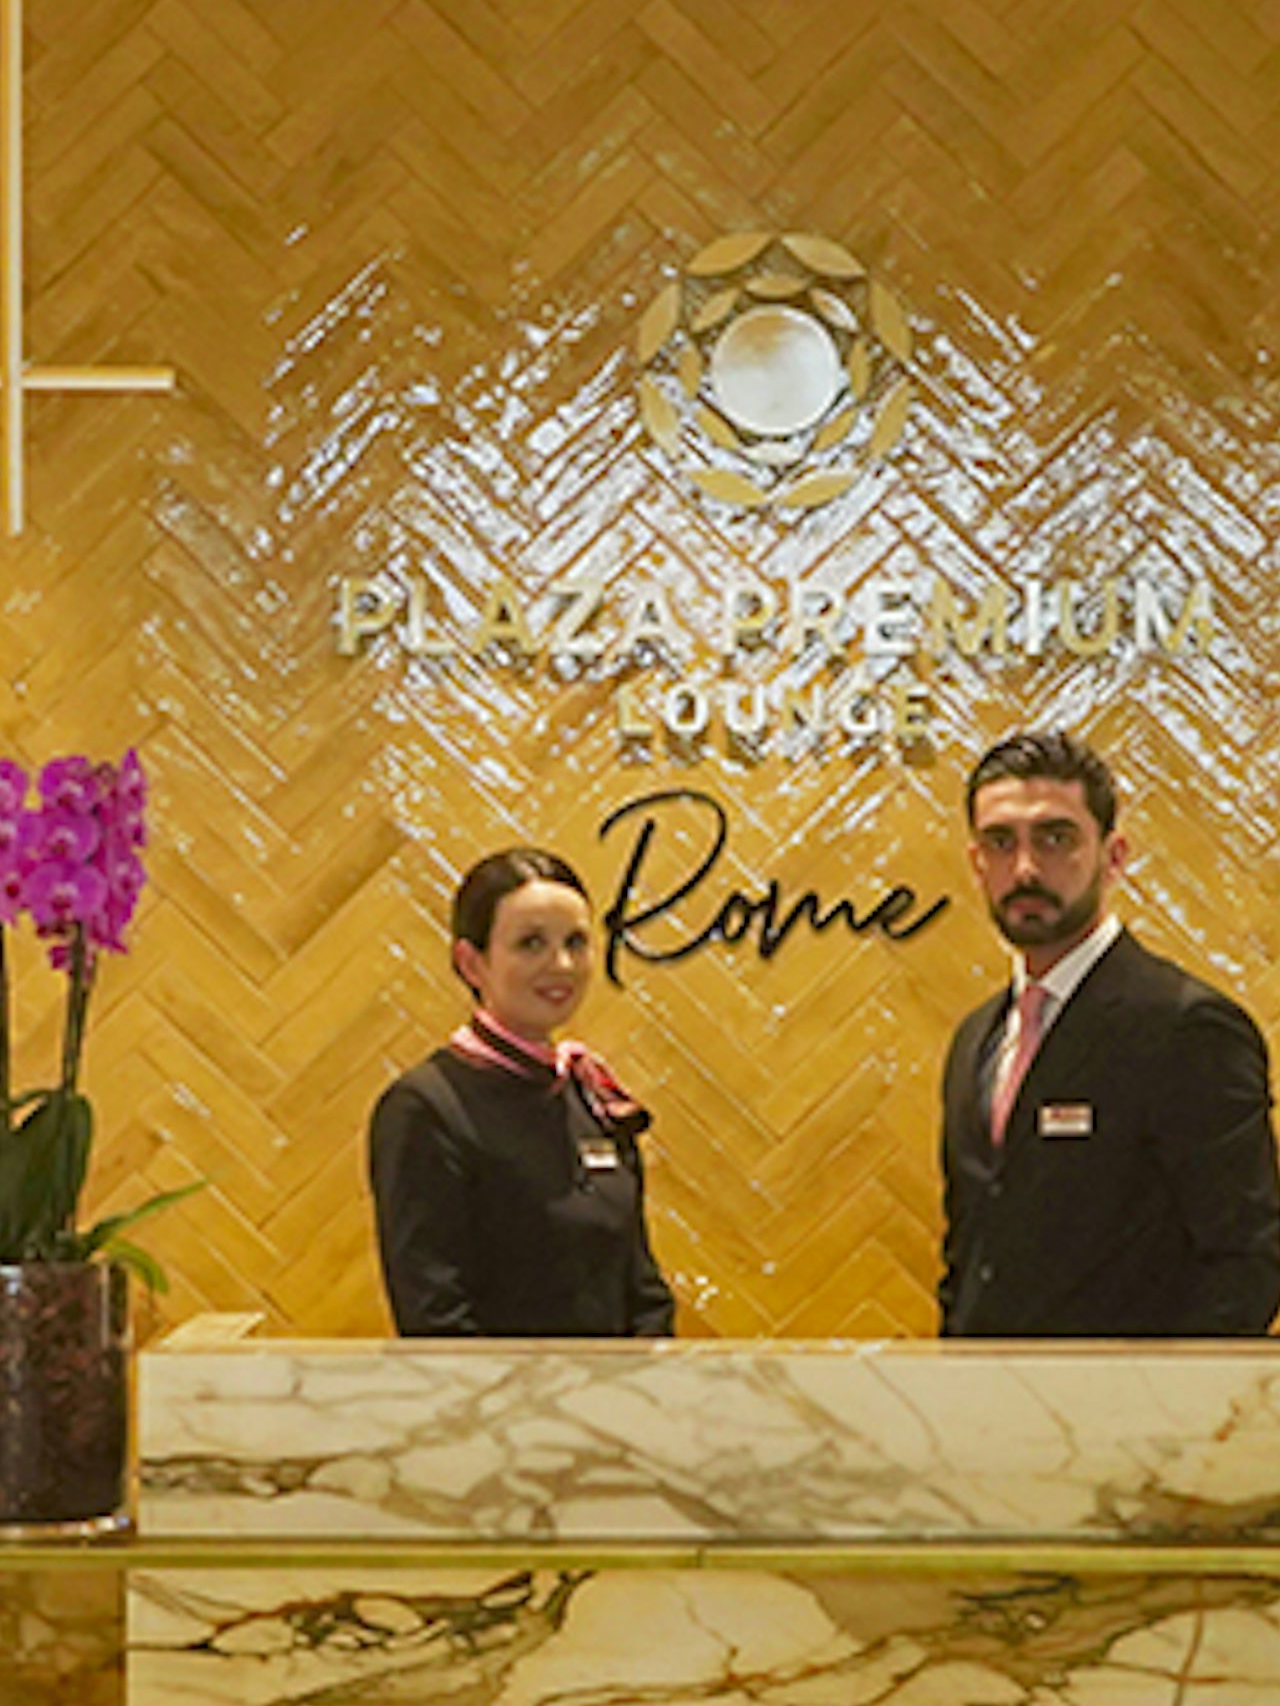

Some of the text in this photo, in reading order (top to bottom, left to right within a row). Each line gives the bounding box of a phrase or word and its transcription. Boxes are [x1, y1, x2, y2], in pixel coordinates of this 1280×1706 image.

[334, 576, 1214, 657] PLAZA PREMIUM
[617, 688, 930, 738] LOUNGE
[600, 789, 950, 988] Rome
